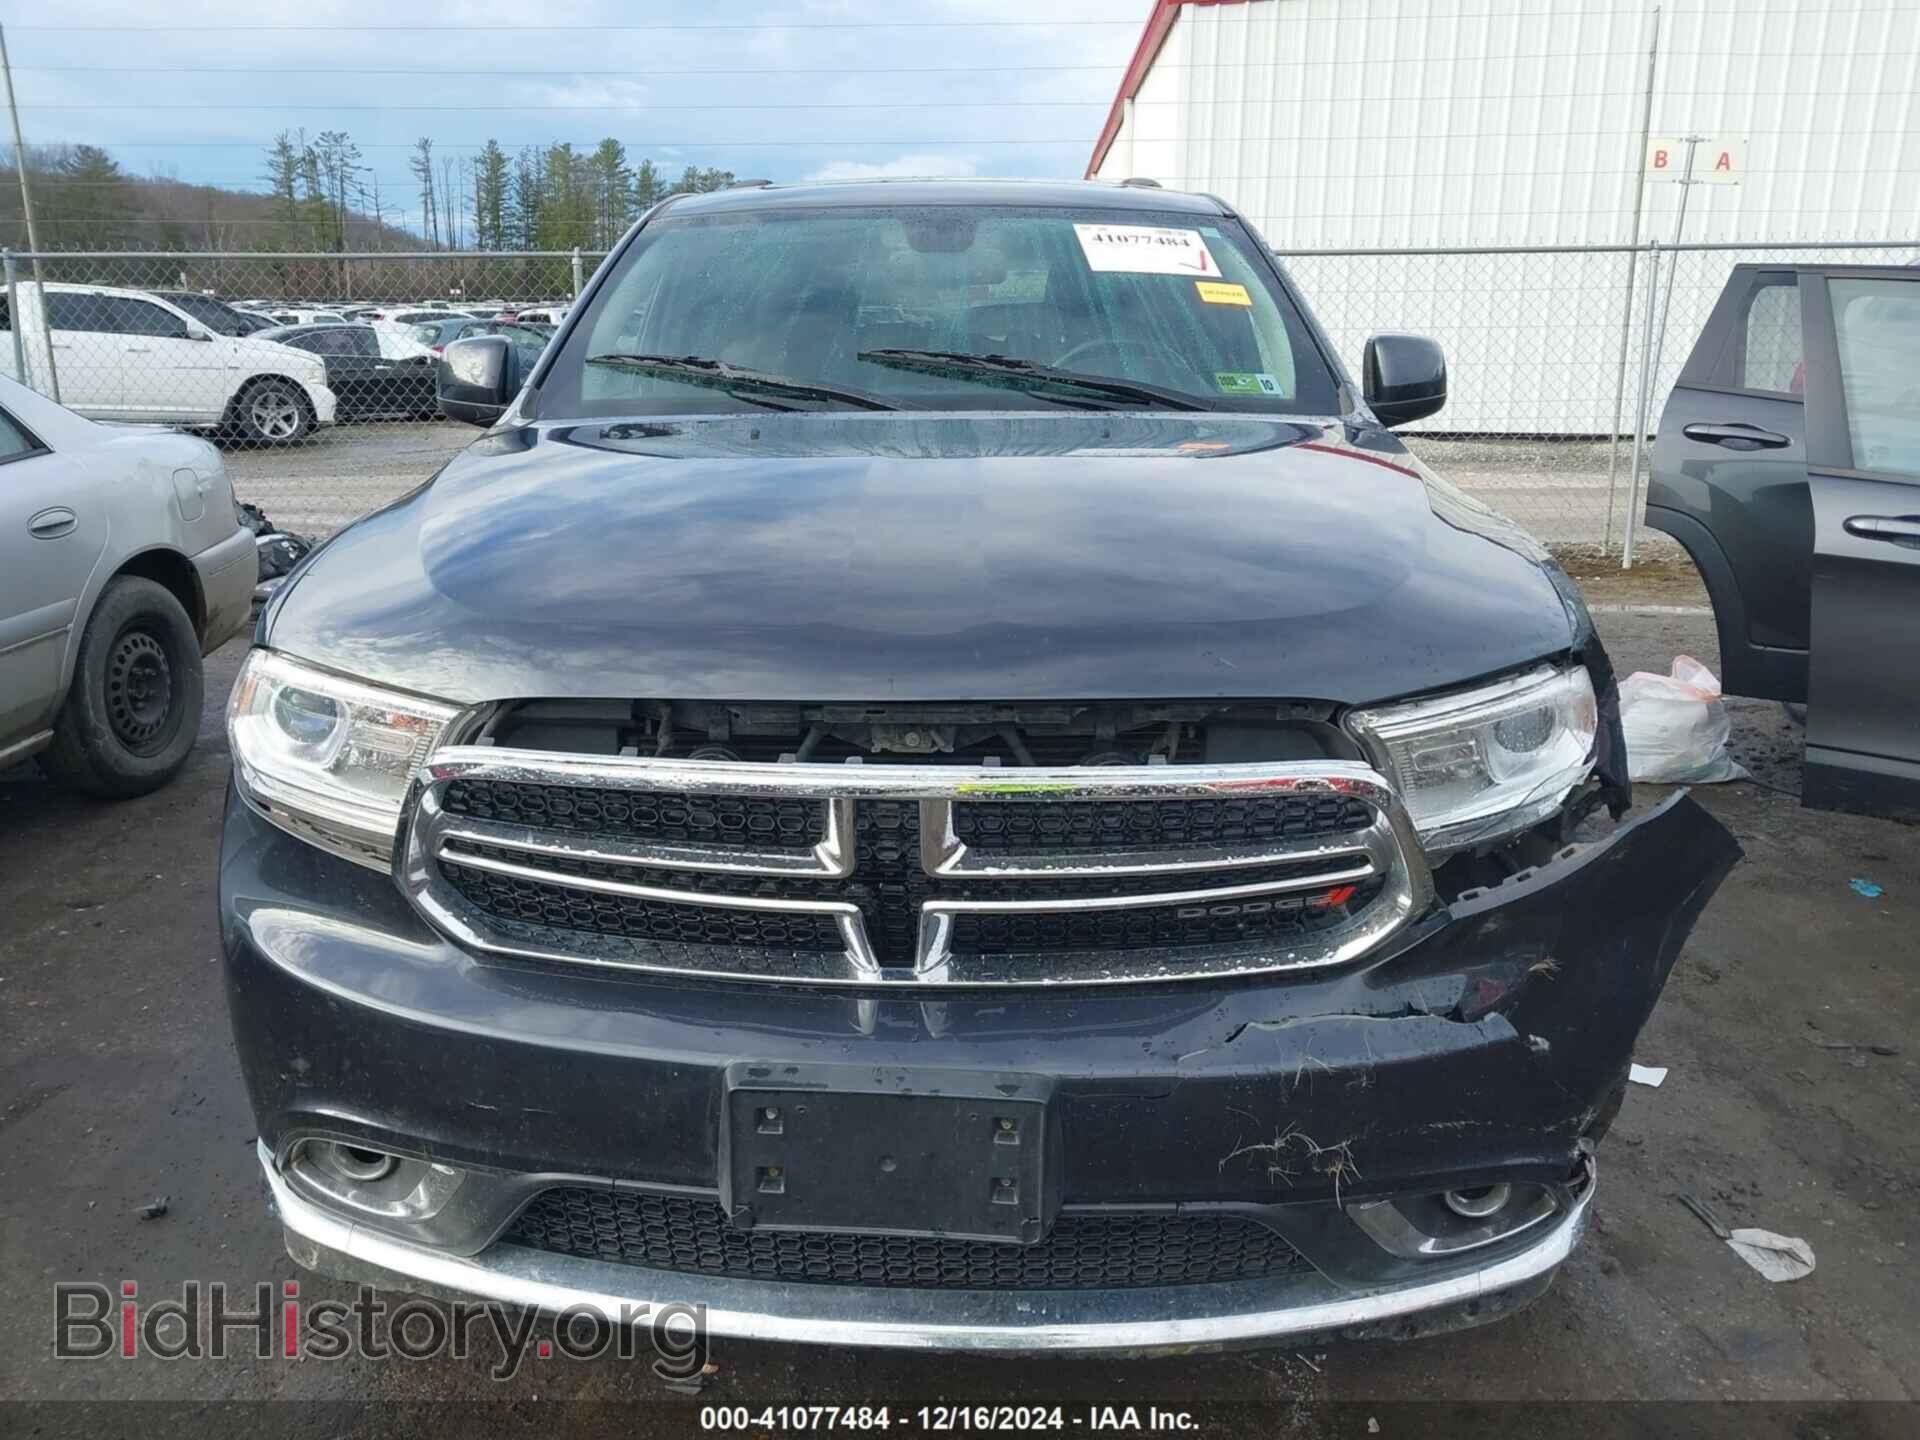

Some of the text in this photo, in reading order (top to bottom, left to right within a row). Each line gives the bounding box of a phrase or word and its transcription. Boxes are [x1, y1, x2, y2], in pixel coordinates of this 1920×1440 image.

[1654, 150, 1668, 168] B
[1715, 152, 1731, 170] A
[1091, 233, 1191, 248] 41077484
[1177, 895, 1330, 918] DODGE
